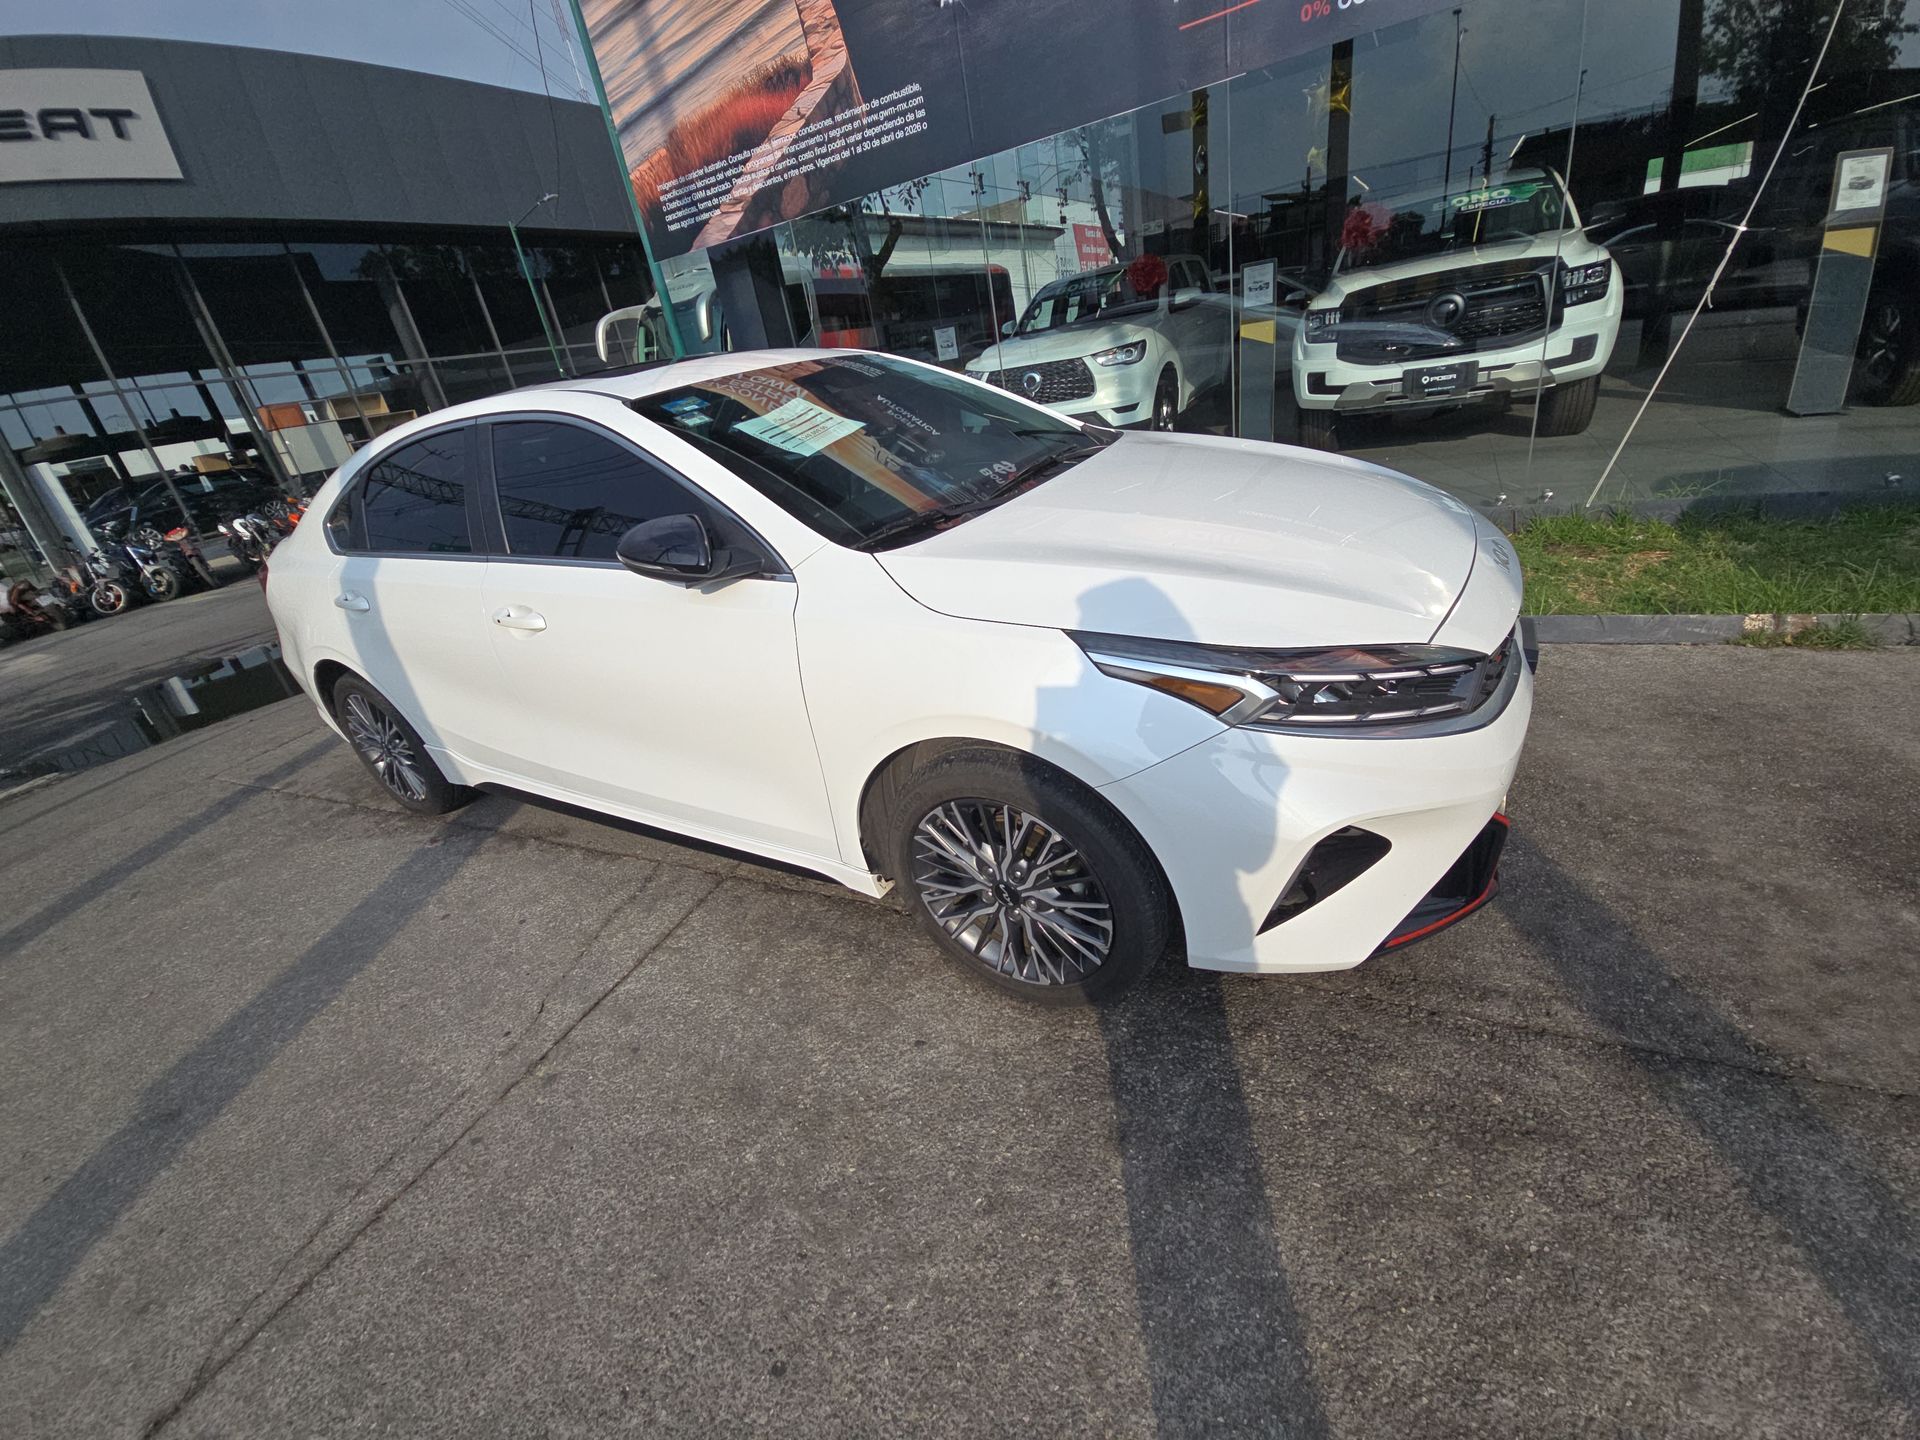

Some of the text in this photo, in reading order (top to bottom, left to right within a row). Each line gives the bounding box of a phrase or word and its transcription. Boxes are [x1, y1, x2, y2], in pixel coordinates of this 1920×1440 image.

[1300, 0, 1331, 21] 0%
[660, 183, 695, 202] especificaciones
[745, 153, 773, 171] programas
[784, 134, 823, 154] financiamiento
[829, 123, 852, 138] seguros
[862, 96, 923, 125] www.gwm-mx.com
[666, 197, 691, 211] Distribuidor
[692, 190, 705, 202] GWM
[706, 182, 731, 196] autorizado.
[732, 174, 751, 186] Precios
[752, 167, 770, 179] sujetos
[798, 151, 814, 162] costo
[815, 144, 827, 156] final
[828, 137, 845, 153] podrá
[846, 132, 862, 144] variar
[864, 116, 904, 138] dependiendo
[915, 108, 925, 119] las
[728, 150, 750, 164] Consulta
[799, 118, 834, 136] condiciones,
[835, 103, 870, 123] rendimiento
[880, 83, 921, 105] combustible,
[698, 200, 711, 210] forma
[753, 175, 783, 191] descuentos,
[800, 162, 815, 174] otros.
[816, 154, 840, 168] Vigencia
[841, 147, 851, 159] del
[881, 131, 894, 145] abril
[905, 121, 921, 137] 2026
[1461, 197, 1513, 211] ESPECIAL
[667, 223, 680, 232] hasta
[681, 217, 695, 228] agotar
